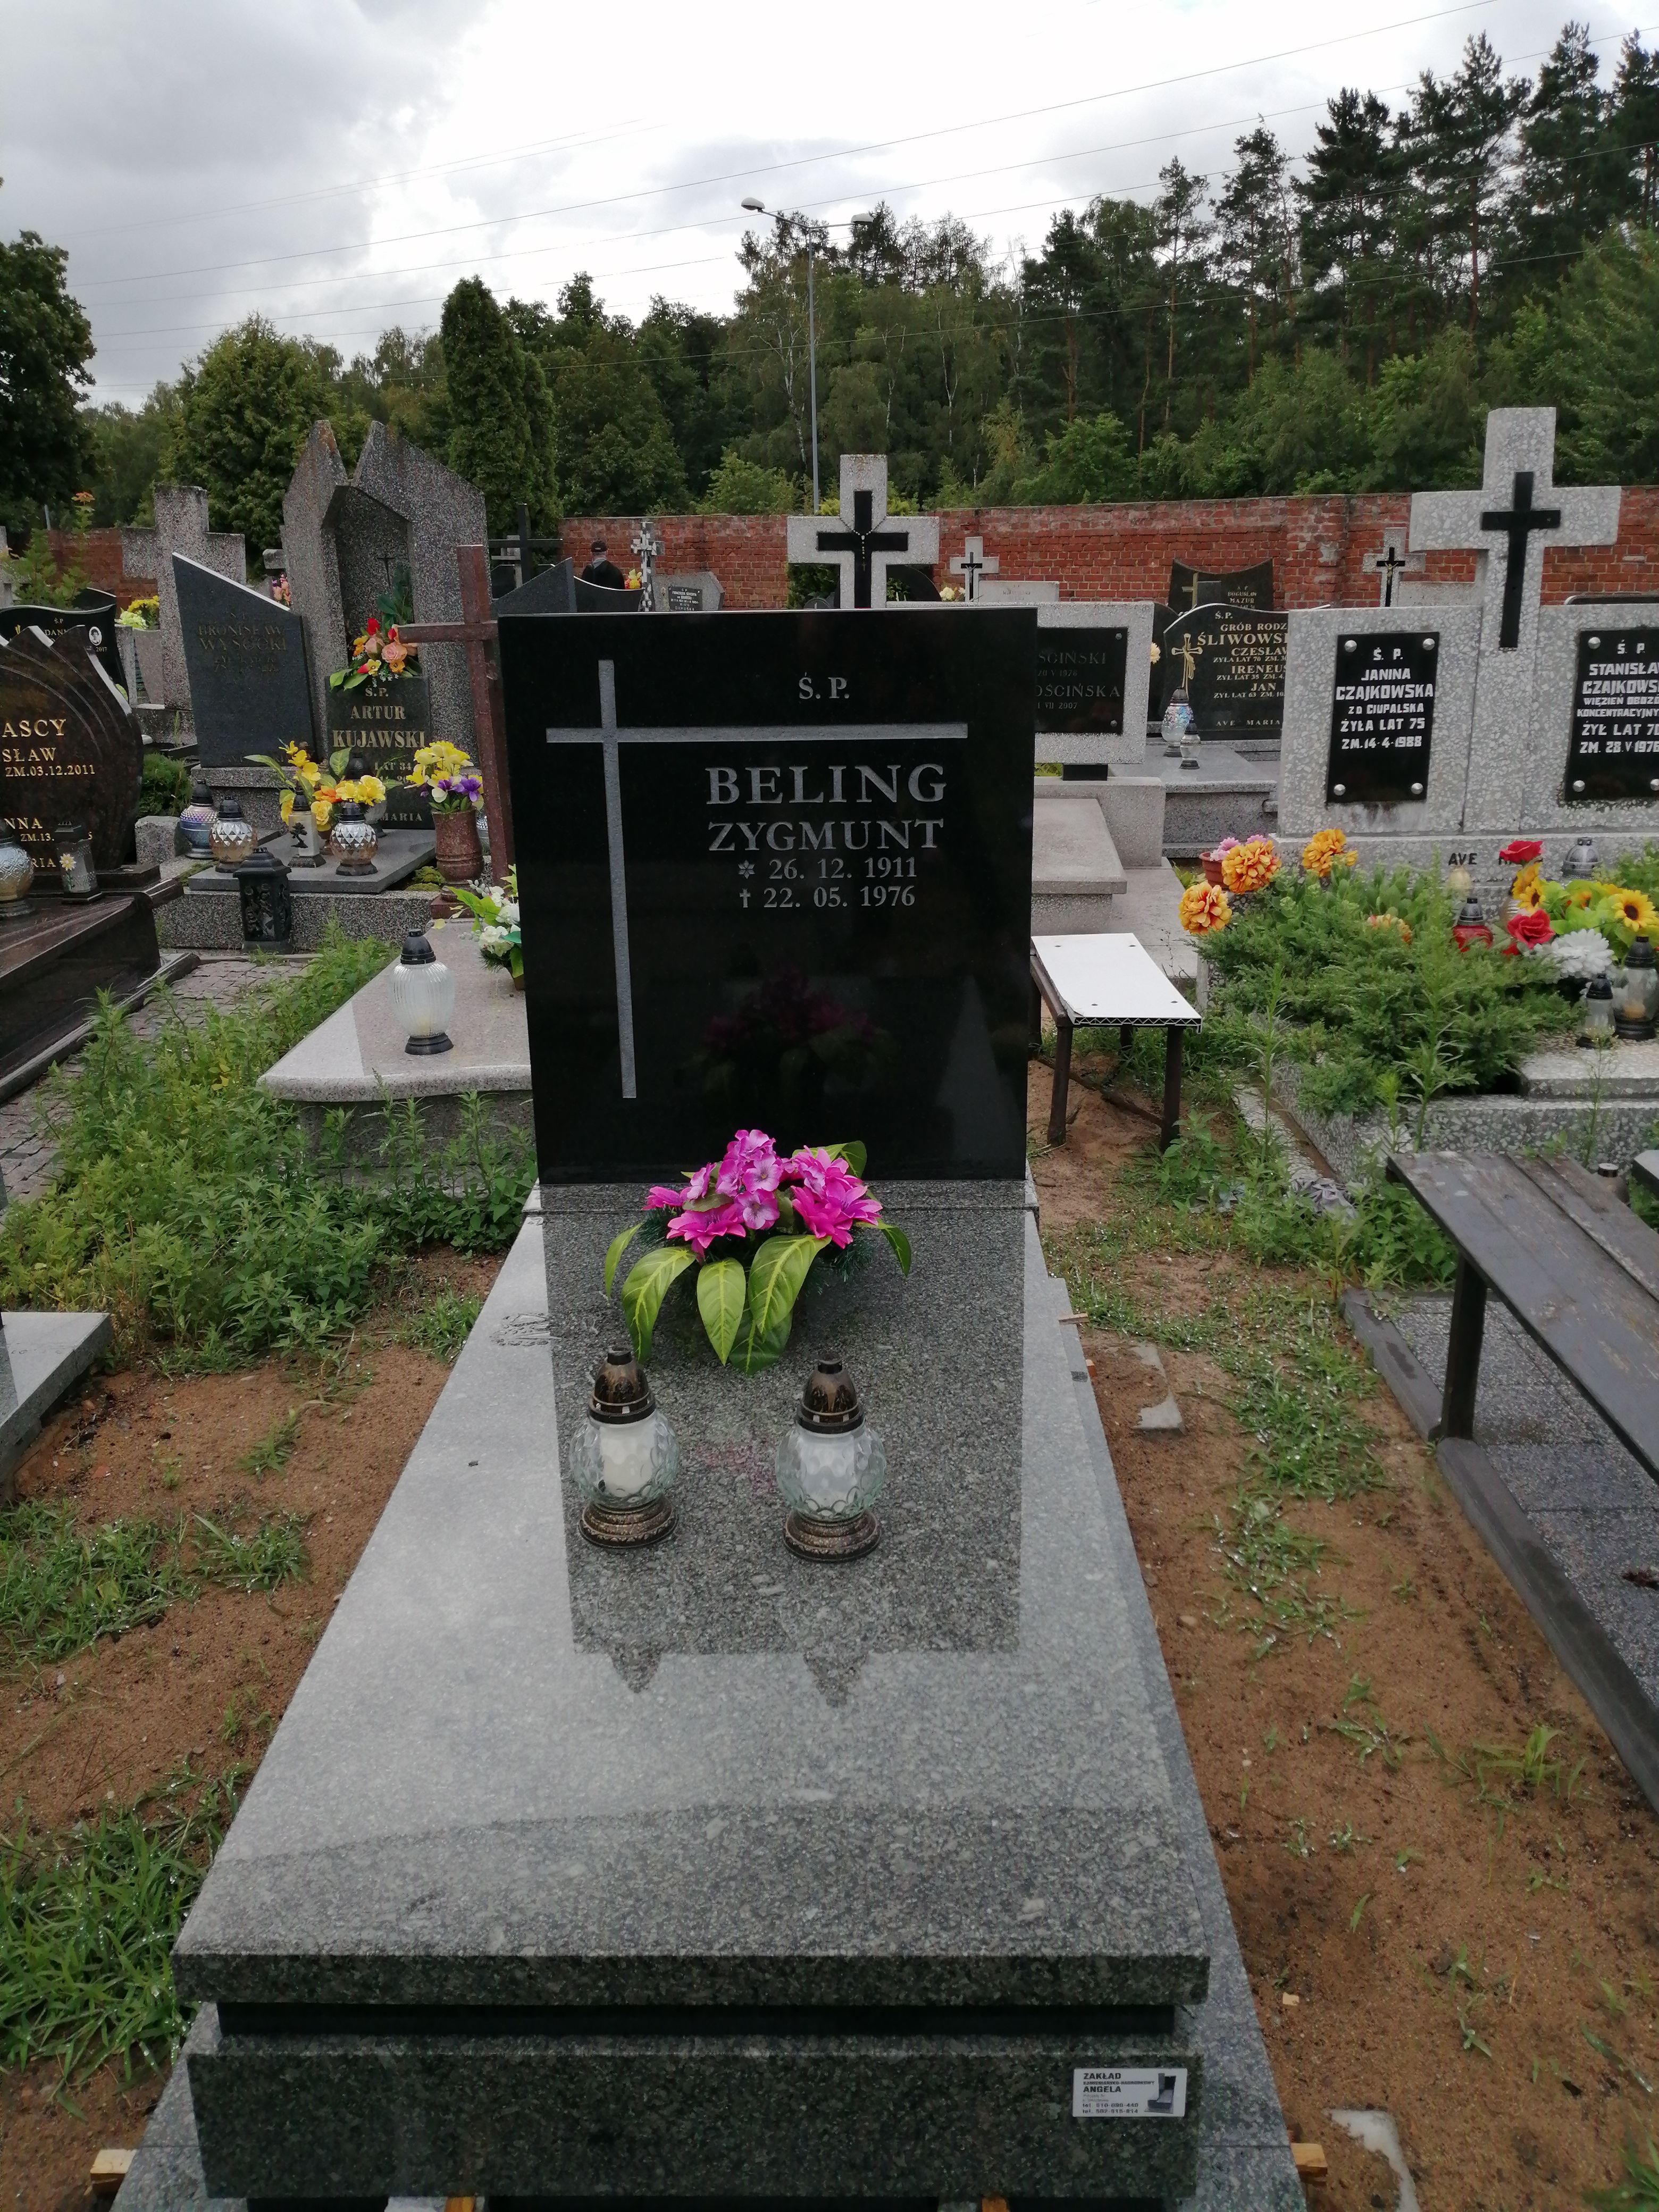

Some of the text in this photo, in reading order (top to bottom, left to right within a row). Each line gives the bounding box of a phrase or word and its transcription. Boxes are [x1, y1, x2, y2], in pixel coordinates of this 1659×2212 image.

[1220, 622, 1252, 631] GRÓB
[1361, 668, 1411, 681] JANINA
[1589, 663, 1659, 676] STANISŁA
[1251, 682, 1276, 691] JAN
[1336, 683, 1434, 701] CZAJKOWSKA
[1582, 679, 1659, 696] CZAJKOWS
[1583, 694, 1624, 707] WIĘZIEŃ
[350, 705, 406, 720] ARTUR
[1366, 703, 1425, 715] CIUPALSKA
[2, 719, 66, 738] ASCY
[1340, 717, 1426, 732] ŻYŁA LAT 75
[1581, 720, 1607, 736] ŻYŁ
[1613, 724, 1642, 736] LAT
[332, 730, 426, 748] KUJAWSKI
[705, 763, 947, 805] BELING
[380, 812, 423, 822] MARIA
[708, 818, 944, 851] ZYGMUNT
[1448, 852, 1478, 866] AVE
[769, 856, 917, 880] 26. 12. 1911
[764, 885, 916, 908] 22. 05. 1976
